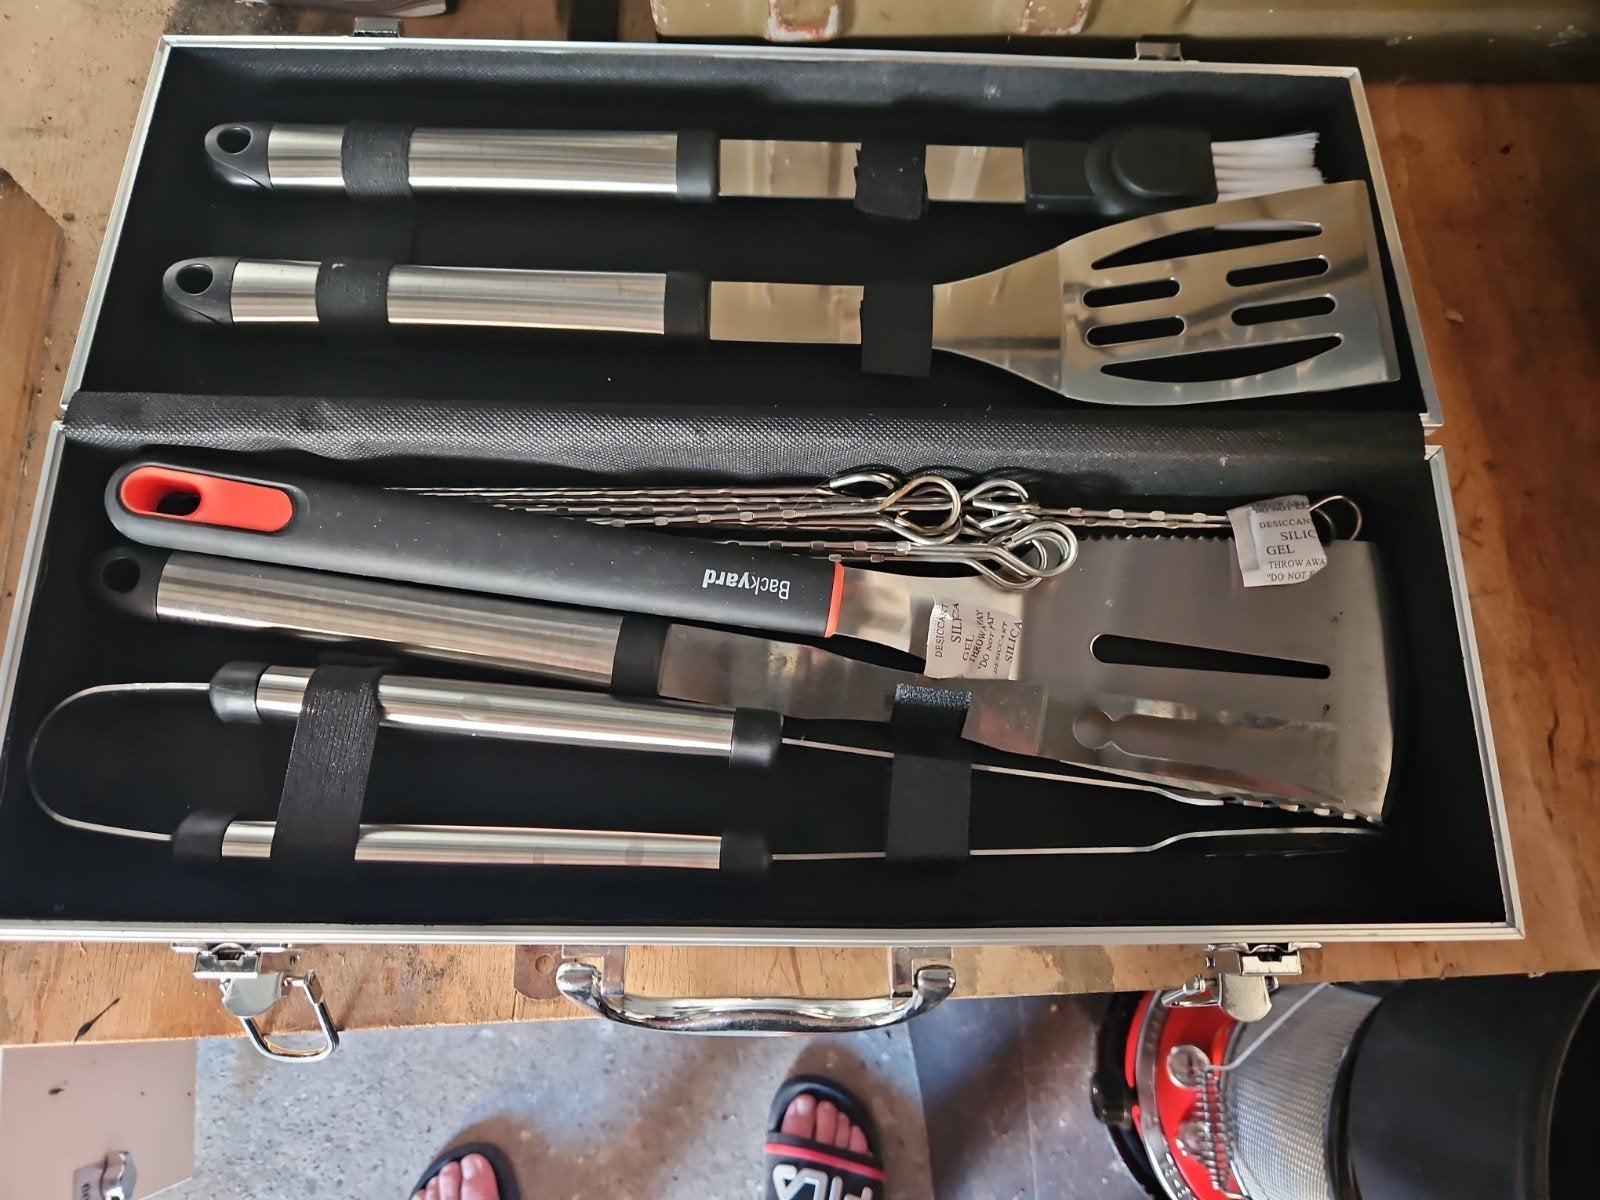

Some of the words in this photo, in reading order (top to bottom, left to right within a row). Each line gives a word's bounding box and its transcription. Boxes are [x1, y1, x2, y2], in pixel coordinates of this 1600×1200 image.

[1280, 529, 1316, 541] SILIC
[1266, 544, 1295, 556] GEL
[1267, 572, 1284, 582] "DO
[1288, 570, 1306, 580] NOT
[1268, 559, 1304, 569] THROW
[702, 568, 791, 600] Backyard
[935, 603, 948, 658] DESICCANT
[951, 602, 962, 643] SILICA
[986, 611, 996, 630] AT"
[962, 634, 975, 661] GEL
[969, 630, 986, 662] THROW
[986, 631, 994, 652] NOT
[993, 621, 1008, 674] DESICCANT
[1004, 621, 1023, 662] SILICA
[977, 653, 990, 670] "DO
